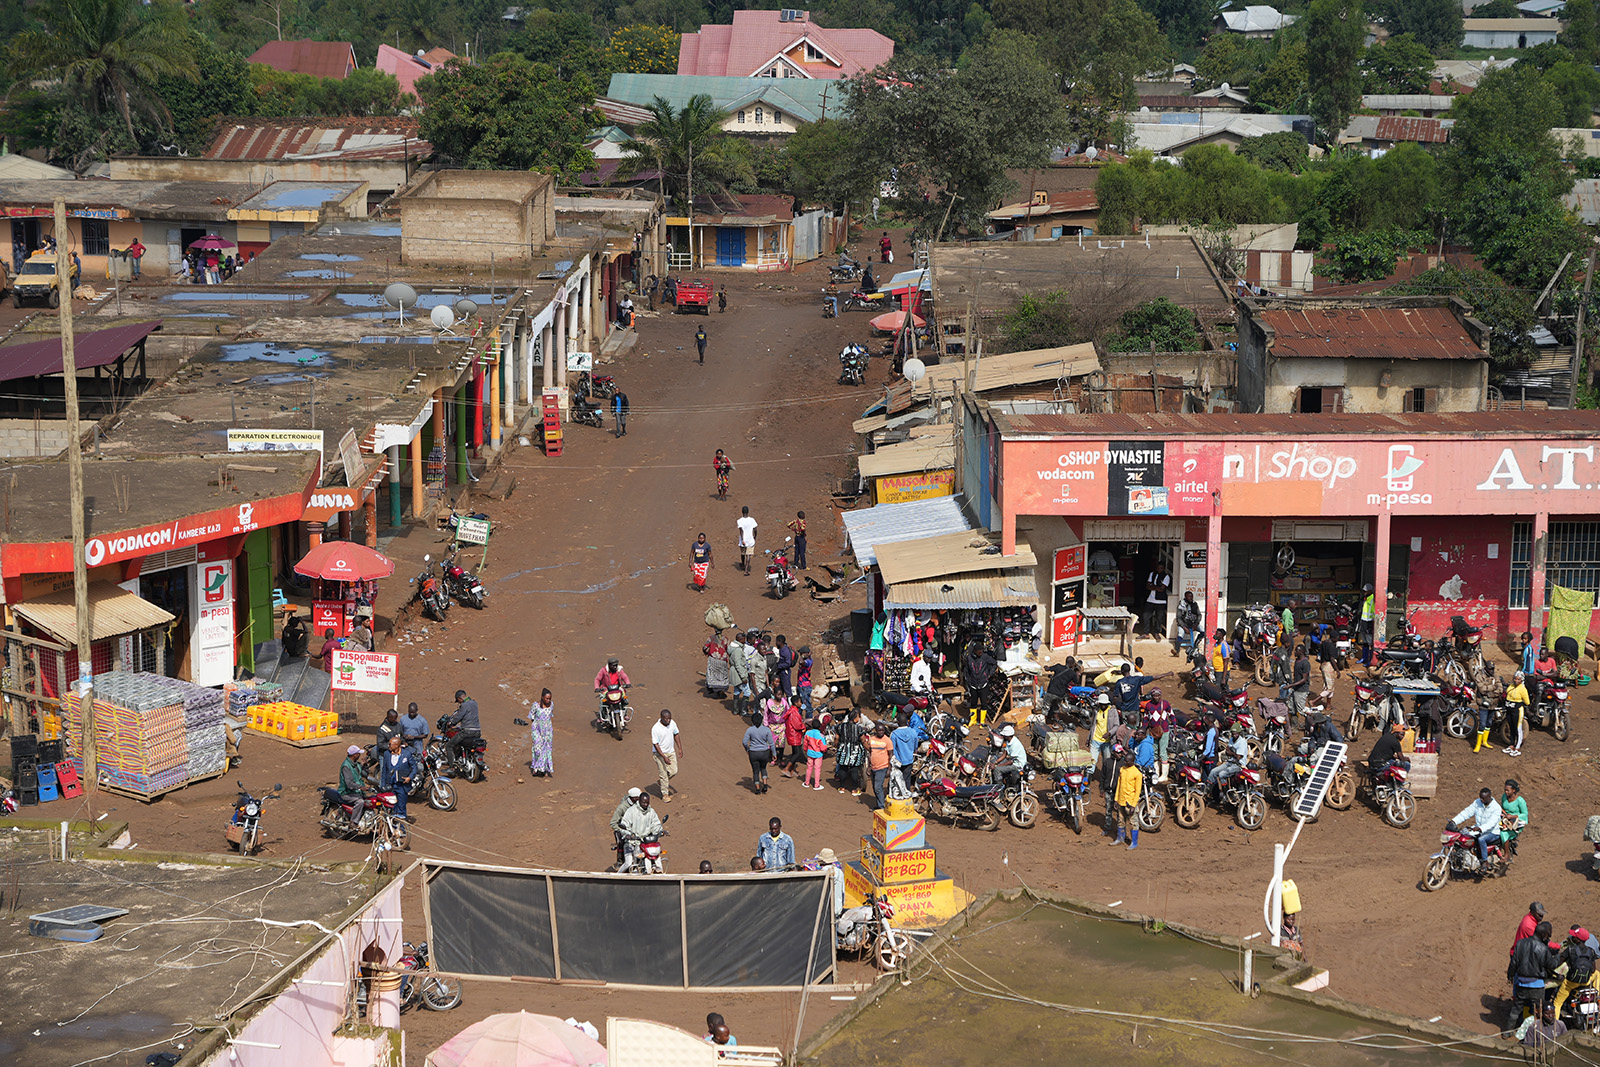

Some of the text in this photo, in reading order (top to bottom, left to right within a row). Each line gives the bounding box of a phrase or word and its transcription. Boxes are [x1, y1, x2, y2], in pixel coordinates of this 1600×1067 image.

[1068, 449, 1162, 465] SHOP DYNASTIE
[1268, 442, 1356, 488] shop
[1036, 468, 1094, 480] vodacom
[882, 474, 928, 491] MAISON
[1174, 481, 1208, 494] airtel
[1366, 493, 1432, 510] m-pesa
[108, 528, 171, 555] VODACOM
[207, 524, 221, 534] KAZI
[200, 607, 230, 620] m-pesa
[888, 850, 934, 863] PARKING
[887, 882, 936, 898] ROND POINT
[900, 901, 934, 912] PANYA
